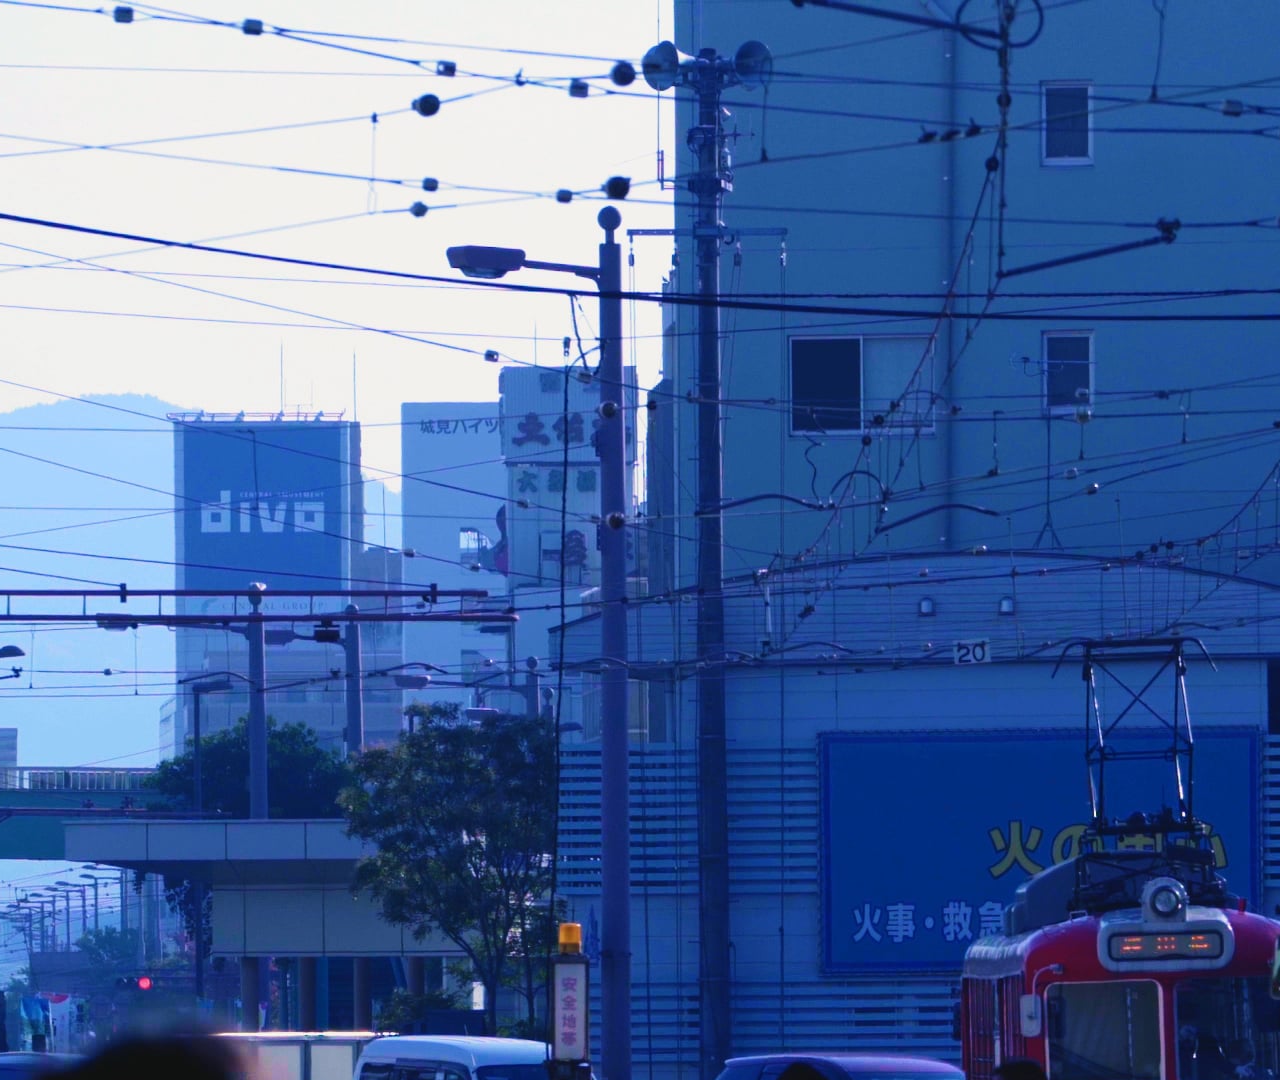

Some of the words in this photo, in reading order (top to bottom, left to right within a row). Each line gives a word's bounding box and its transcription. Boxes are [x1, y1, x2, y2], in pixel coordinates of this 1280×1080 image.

[421, 419, 498, 434] 城見ハイツ
[957, 642, 985, 663] 20
[561, 977, 577, 1047] 安全地帯
